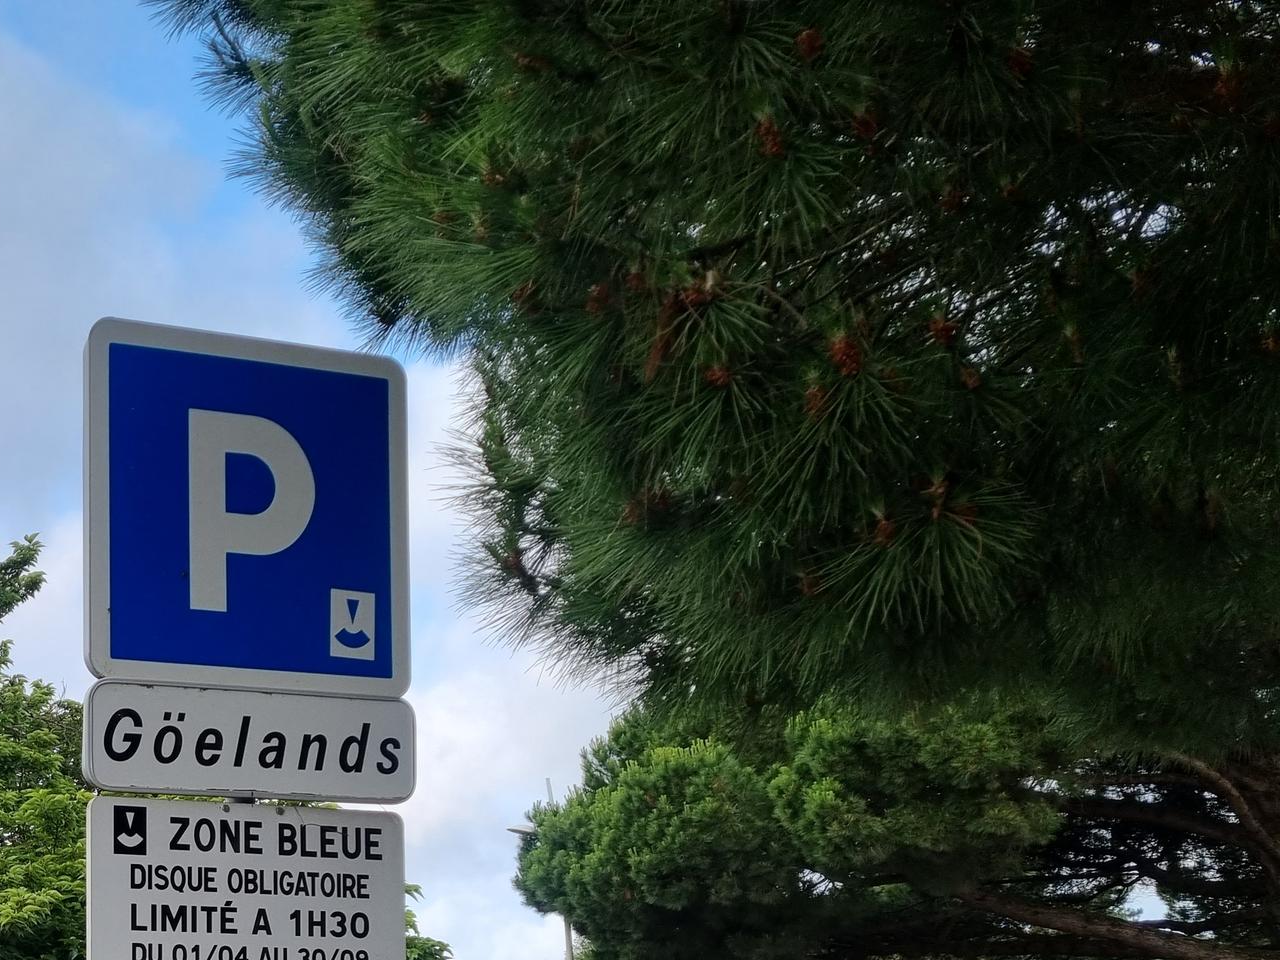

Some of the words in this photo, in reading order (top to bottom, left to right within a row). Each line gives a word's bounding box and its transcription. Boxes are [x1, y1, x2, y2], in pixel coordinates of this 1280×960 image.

[188, 408, 316, 613] P
[103, 707, 401, 775] Göelands
[169, 816, 263, 855] ZONE
[278, 822, 383, 861] BLEUE
[130, 863, 218, 893] DISQUE
[227, 868, 370, 899] OBLIGATOIRE
[130, 900, 238, 935] LIMITÉ
[252, 908, 272, 936] A
[289, 909, 370, 939] 1H30
